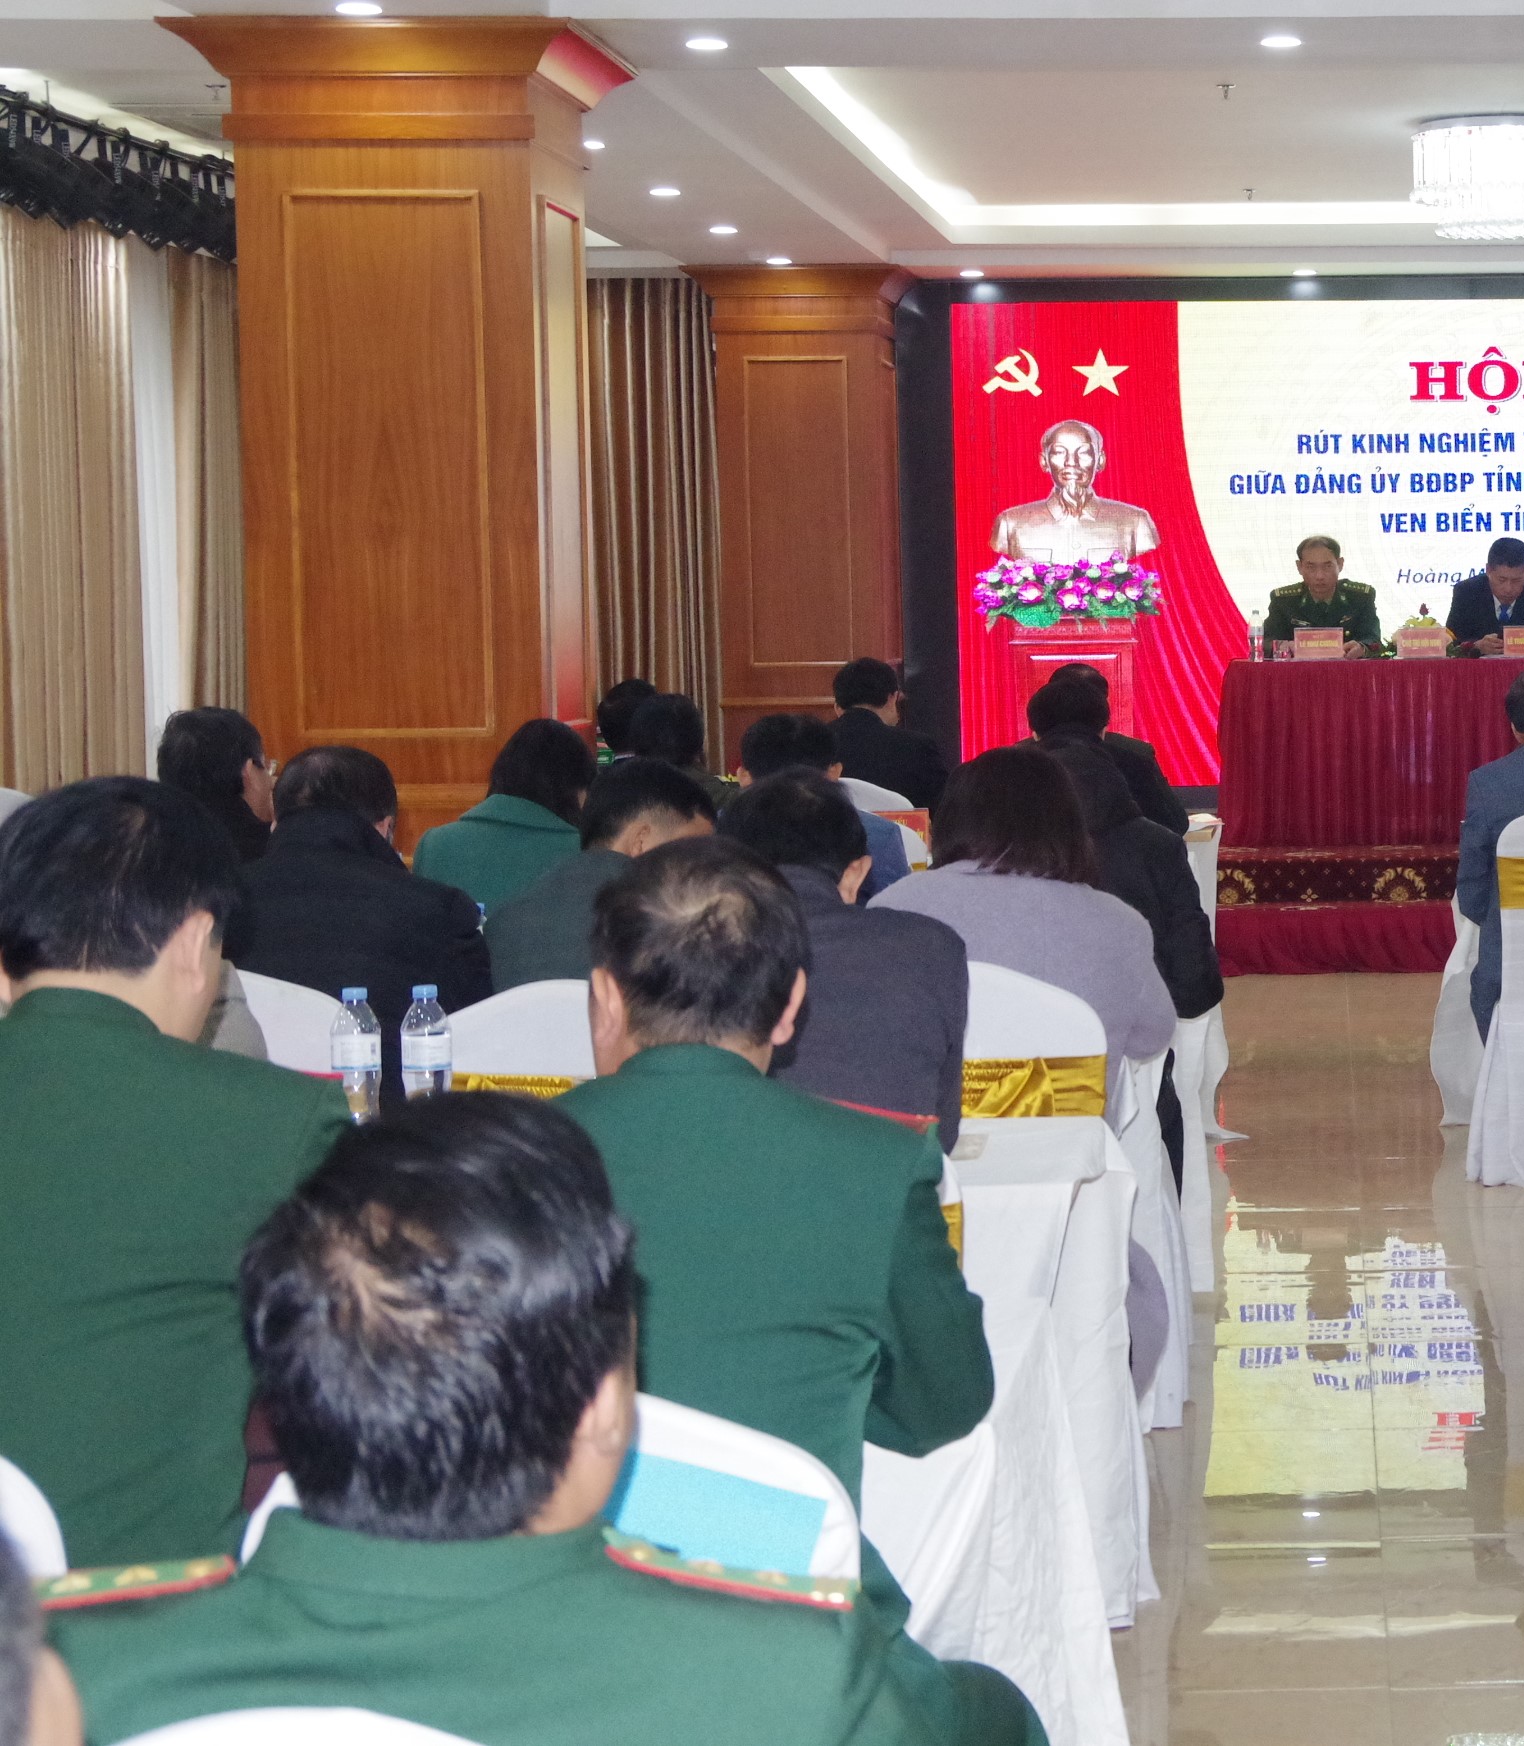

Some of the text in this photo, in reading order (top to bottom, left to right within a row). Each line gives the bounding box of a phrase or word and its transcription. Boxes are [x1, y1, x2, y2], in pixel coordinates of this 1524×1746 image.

[1297, 430, 1343, 454] RÚT
[1351, 433, 1410, 453] KINH
[1419, 428, 1515, 457] NGHIỆM
[1229, 470, 1287, 494] GIỮA
[1295, 467, 1362, 494] ĐẢNG
[1371, 466, 1401, 494] ỦY
[1410, 472, 1475, 493] BĐBP
[1380, 512, 1427, 533] VEN
[1436, 504, 1492, 532] BIỂN
[1397, 568, 1462, 586] Hoàng
